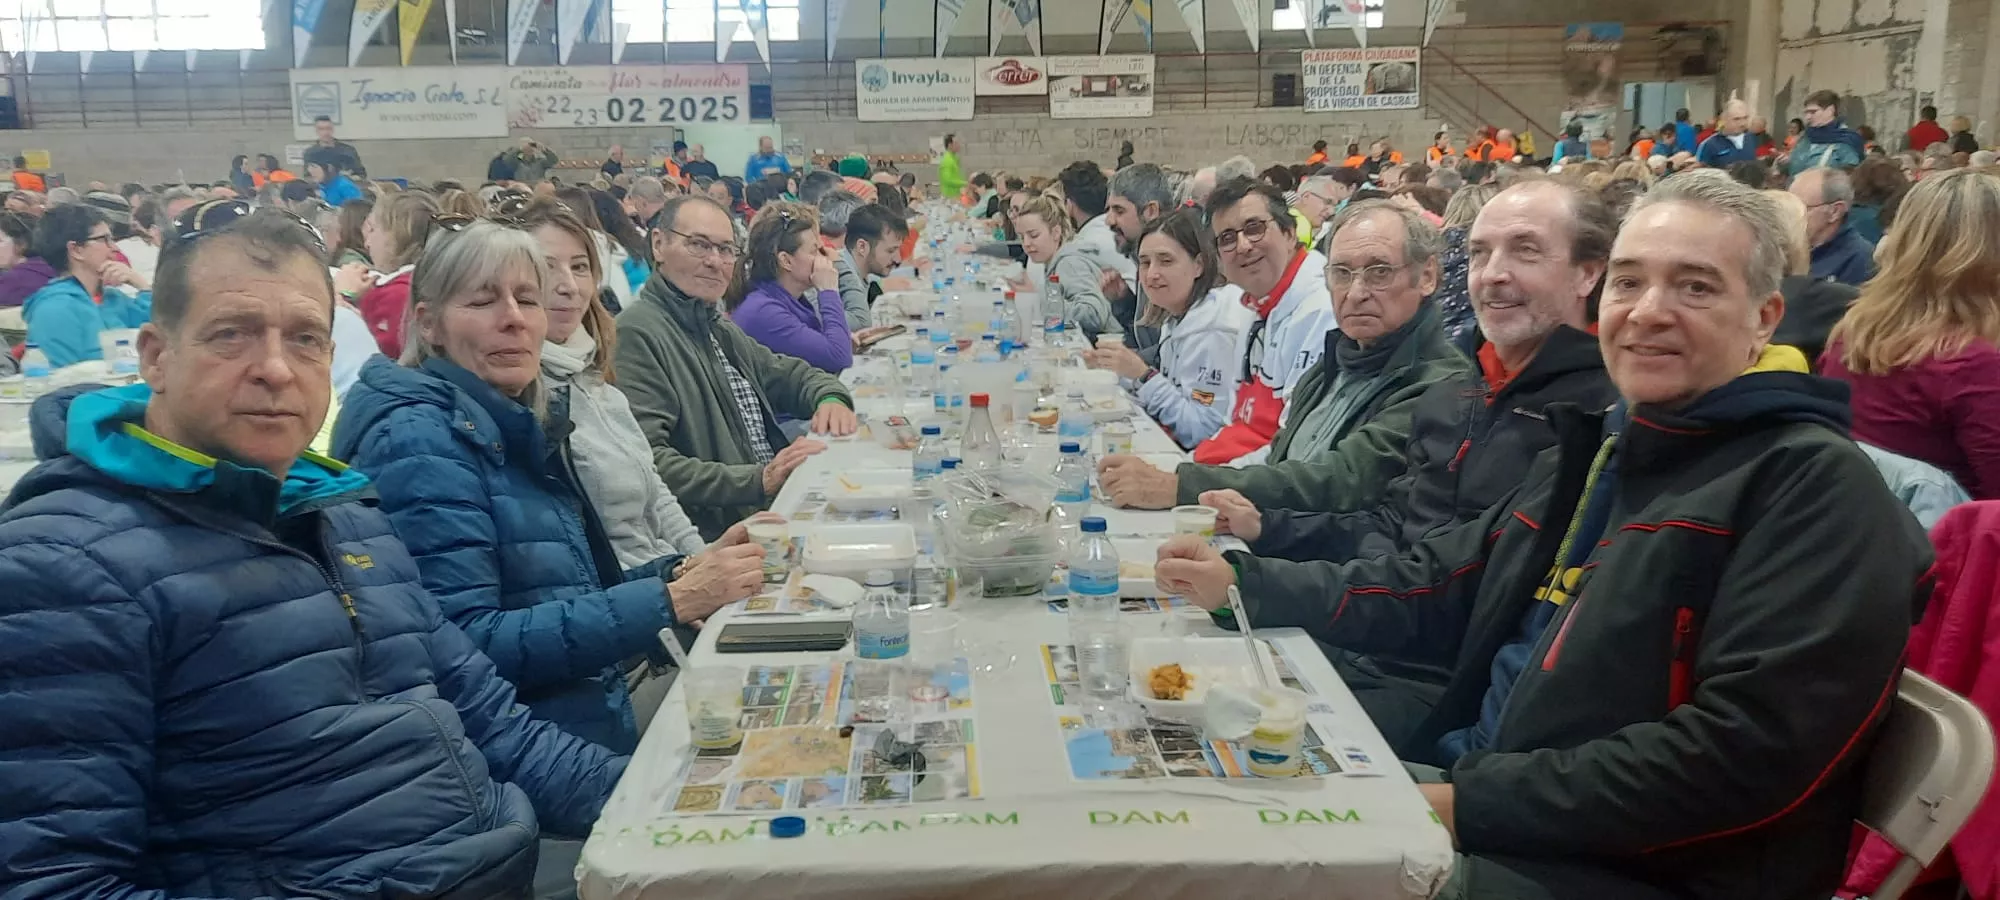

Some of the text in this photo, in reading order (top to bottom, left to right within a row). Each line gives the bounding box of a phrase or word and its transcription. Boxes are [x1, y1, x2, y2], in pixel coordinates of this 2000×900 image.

[1304, 49, 1416, 61] PLATAFORMA CIUDADANA
[1304, 63, 1361, 75] EN DEFENSA
[510, 75, 582, 90] Caminata
[892, 69, 949, 87] Invayla
[1319, 75, 1346, 86] DE LA
[350, 78, 416, 110] Ignacio
[1304, 85, 1359, 97] PROPIEDAD
[547, 95, 571, 113] 22
[863, 95, 971, 105] ALQUILER DE APARTAMENTOS
[1304, 99, 1316, 109] DE
[1317, 98, 1329, 108] LA
[1330, 97, 1364, 108] VIRGEN
[1367, 96, 1378, 106] DE
[1089, 809, 1190, 825] DAM
[1257, 808, 1360, 825] DAM
